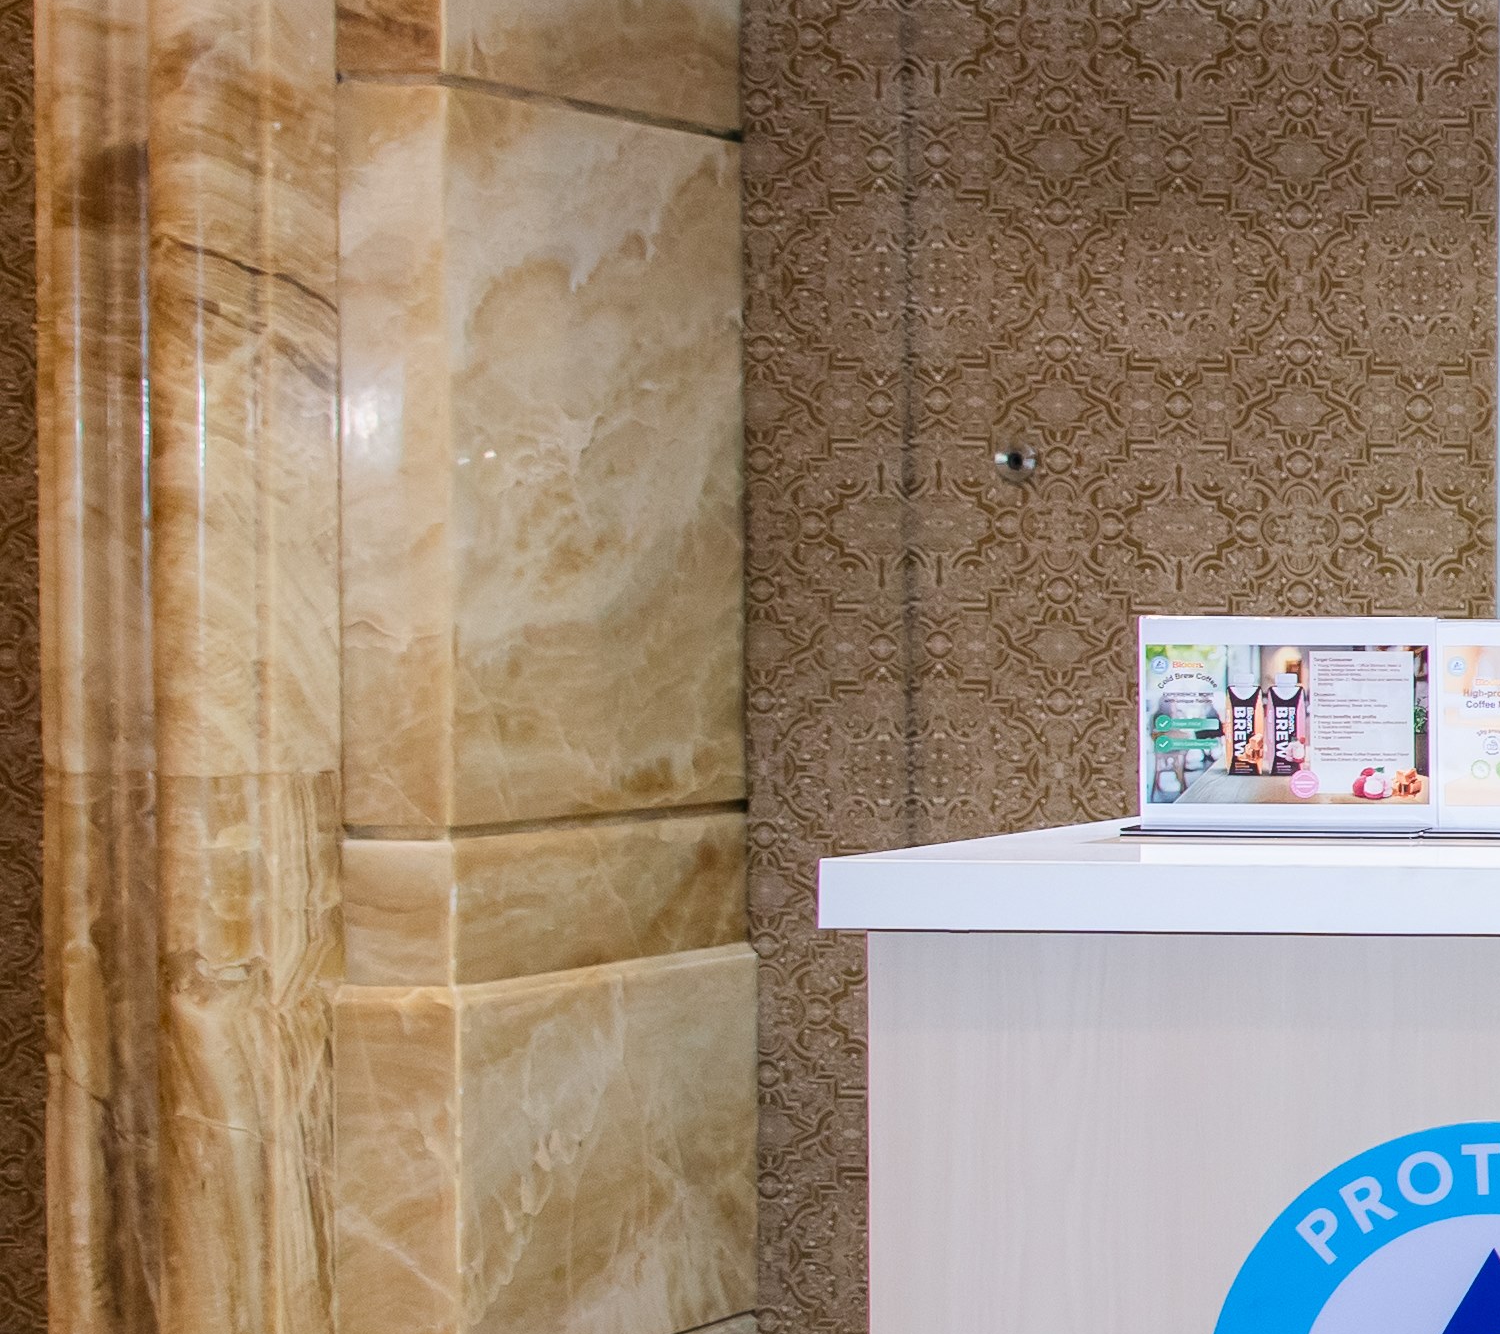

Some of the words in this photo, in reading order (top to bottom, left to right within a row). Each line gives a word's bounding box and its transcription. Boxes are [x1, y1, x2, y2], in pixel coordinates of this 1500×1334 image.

[1157, 675, 1174, 689] Cold
[1174, 672, 1194, 680] Brew
[1196, 672, 1218, 689] Coffee
[1466, 700, 1496, 709] Coffee
